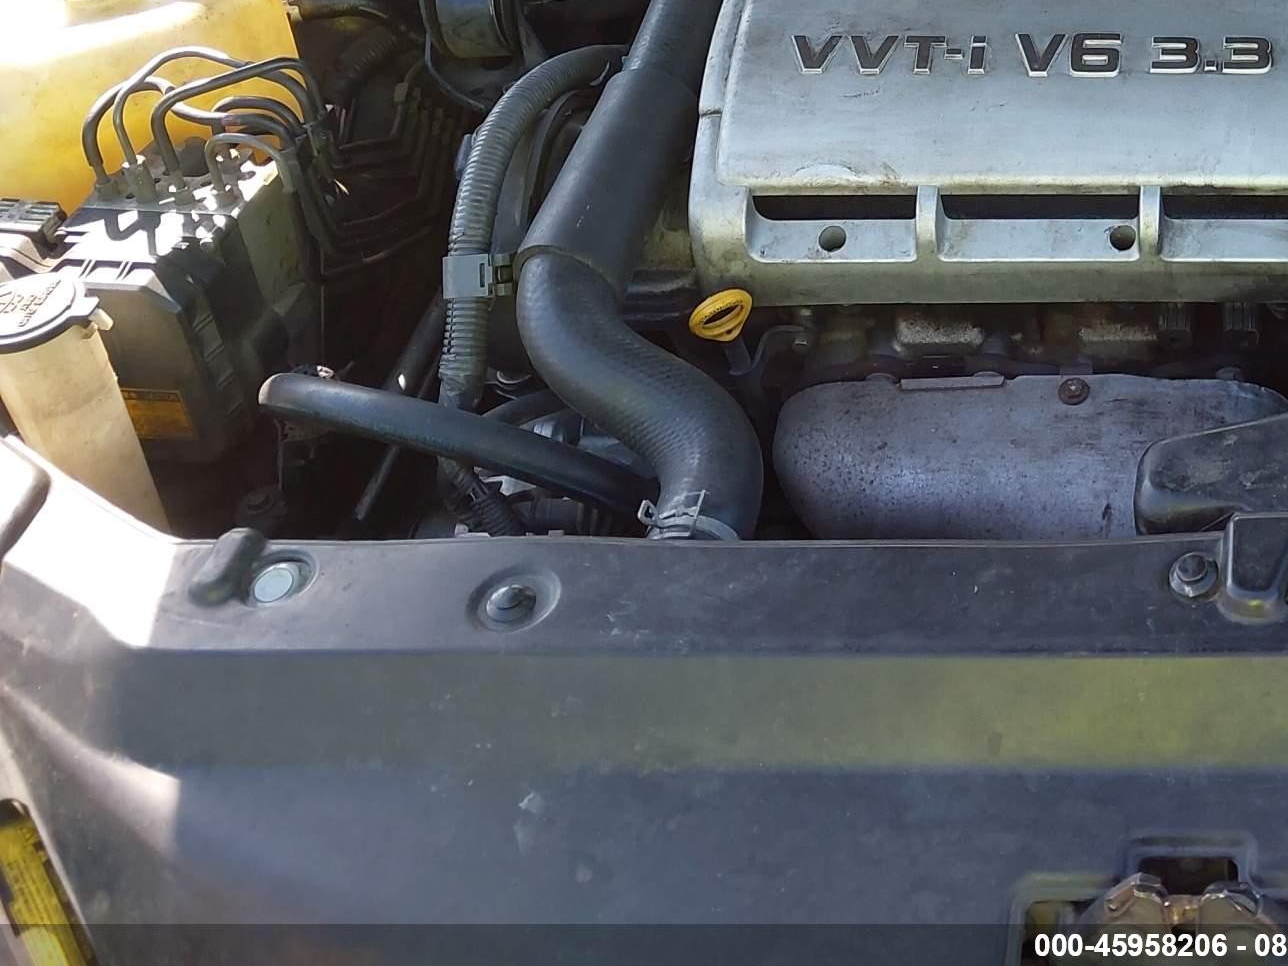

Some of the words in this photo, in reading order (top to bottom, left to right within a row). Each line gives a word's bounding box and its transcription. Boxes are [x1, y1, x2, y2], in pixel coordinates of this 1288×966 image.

[792, 34, 989, 76] VVT-i
[1014, 32, 1123, 78] V6
[1149, 35, 1274, 76] 3.3
